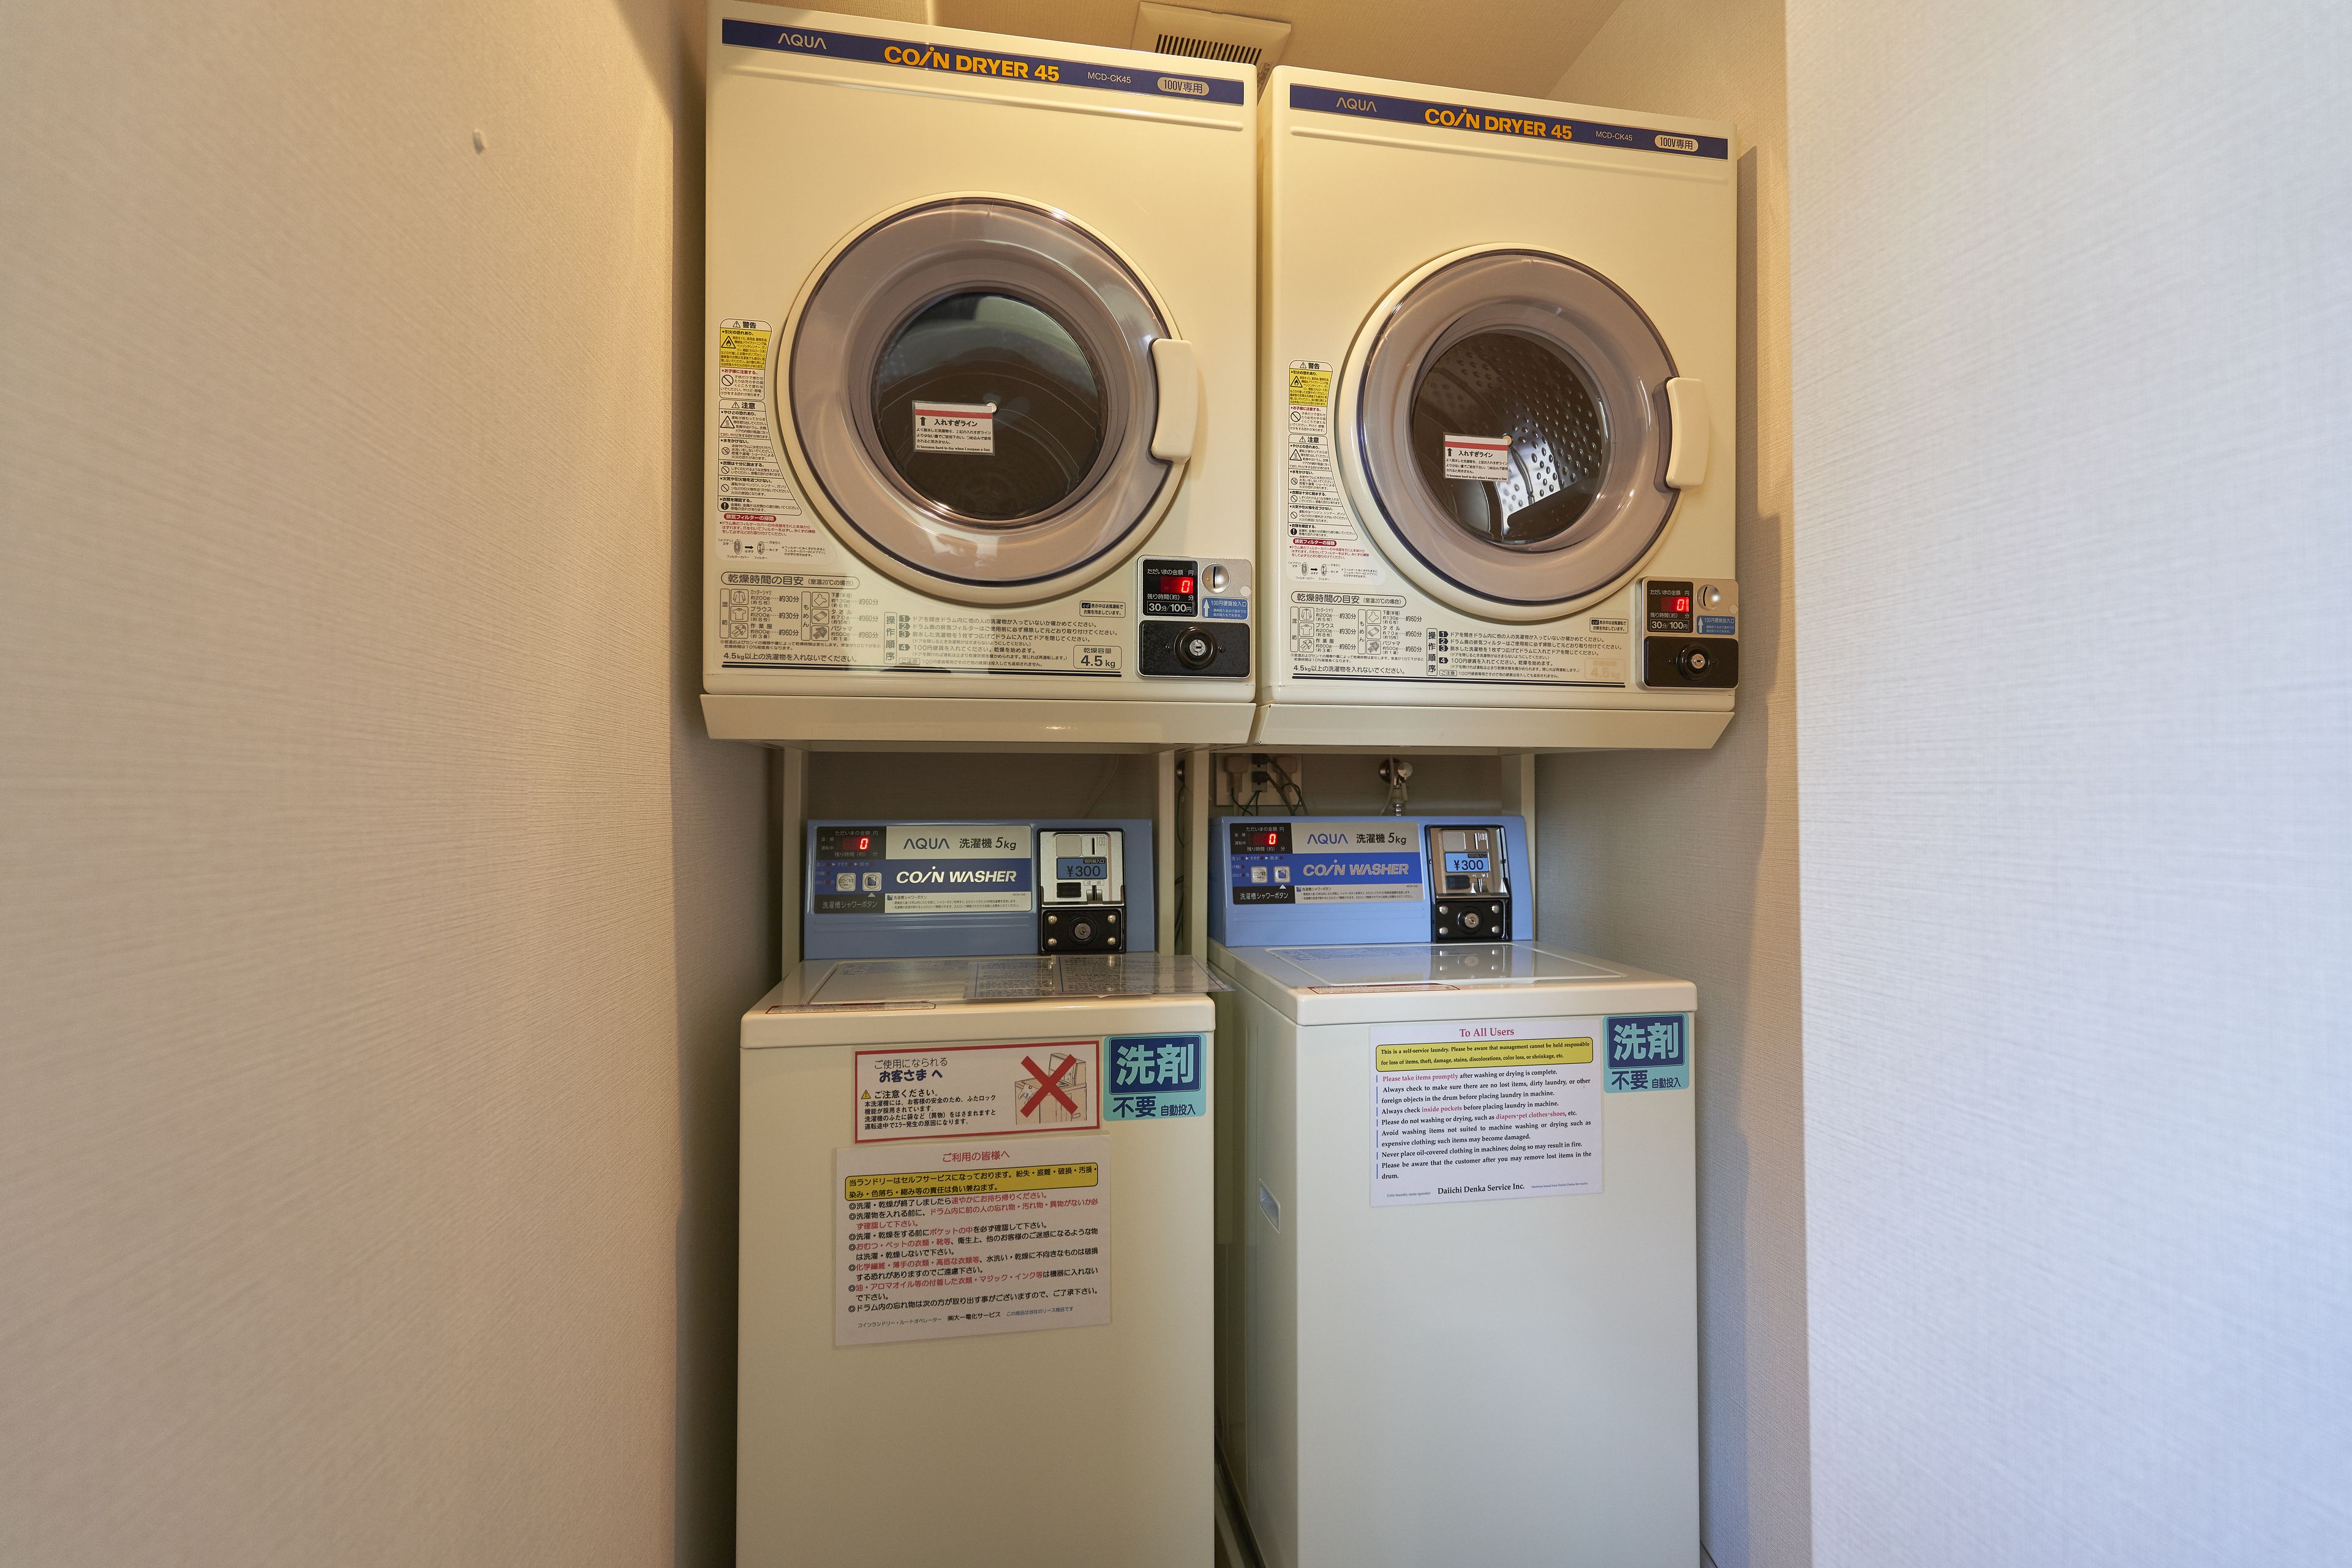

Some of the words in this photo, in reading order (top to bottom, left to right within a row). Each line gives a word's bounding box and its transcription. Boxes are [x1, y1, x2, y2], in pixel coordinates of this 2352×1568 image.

[778, 32, 827, 50] AQUA
[956, 55, 1029, 80] DRYER
[1034, 64, 1059, 83] 45
[1088, 72, 1131, 85] MCD-CK45
[1164, 80, 1203, 93] 100V専用
[1336, 98, 1377, 112] AQUA
[1485, 116, 1547, 137] DRYER
[1551, 125, 1572, 140] 45
[1596, 130, 1633, 141] MCD-CK45
[1659, 137, 1693, 150] 100V専用
[728, 574, 804, 586] 乾燥時間の目安
[1182, 581, 1189, 593] 0
[1297, 594, 1360, 604] 乾燥時間の目安
[723, 652, 857, 662] 4.5kg以上の洗濯物を入れないでください。
[1080, 655, 1102, 666] 4.5
[1294, 665, 1404, 674] 4.5kg以上の洗濯物を入れないでください。
[860, 839, 869, 850] 0
[903, 839, 949, 850] AQUA
[959, 837, 992, 849] 洗濯機
[996, 837, 1016, 851] 5kg
[1269, 834, 1276, 845] 0
[1307, 834, 1348, 845] AQUA
[1356, 834, 1385, 843] 洗濯機
[1388, 832, 1406, 845] 5kg
[1349, 864, 1409, 875] WASHER
[1453, 859, 1483, 870] ¥300
[950, 870, 1016, 883] WASHER
[1066, 865, 1101, 877] ¥300
[1458, 1028, 1471, 1037] To
[1472, 1027, 1487, 1037] All
[1489, 1027, 1514, 1036] Users
[1613, 1023, 1678, 1060] 洗剤
[875, 1058, 948, 1069] ご使用になられる
[1116, 1044, 1194, 1087] 洗剤
[1432, 1072, 1458, 1081] promptly
[1611, 1070, 1648, 1090] 不要
[1652, 1077, 1681, 1088] 自動投入
[875, 1088, 938, 1099] ご注意ください。
[864, 1106, 933, 1114] 機能が採用されています。
[1112, 1096, 1156, 1118] 不要
[1160, 1104, 1196, 1117] 自動投入
[943, 1150, 1010, 1163] ご利用の皆様へ
[1437, 1186, 1462, 1194] Daiichi
[857, 1220, 918, 1229] ず確認して下さい。
